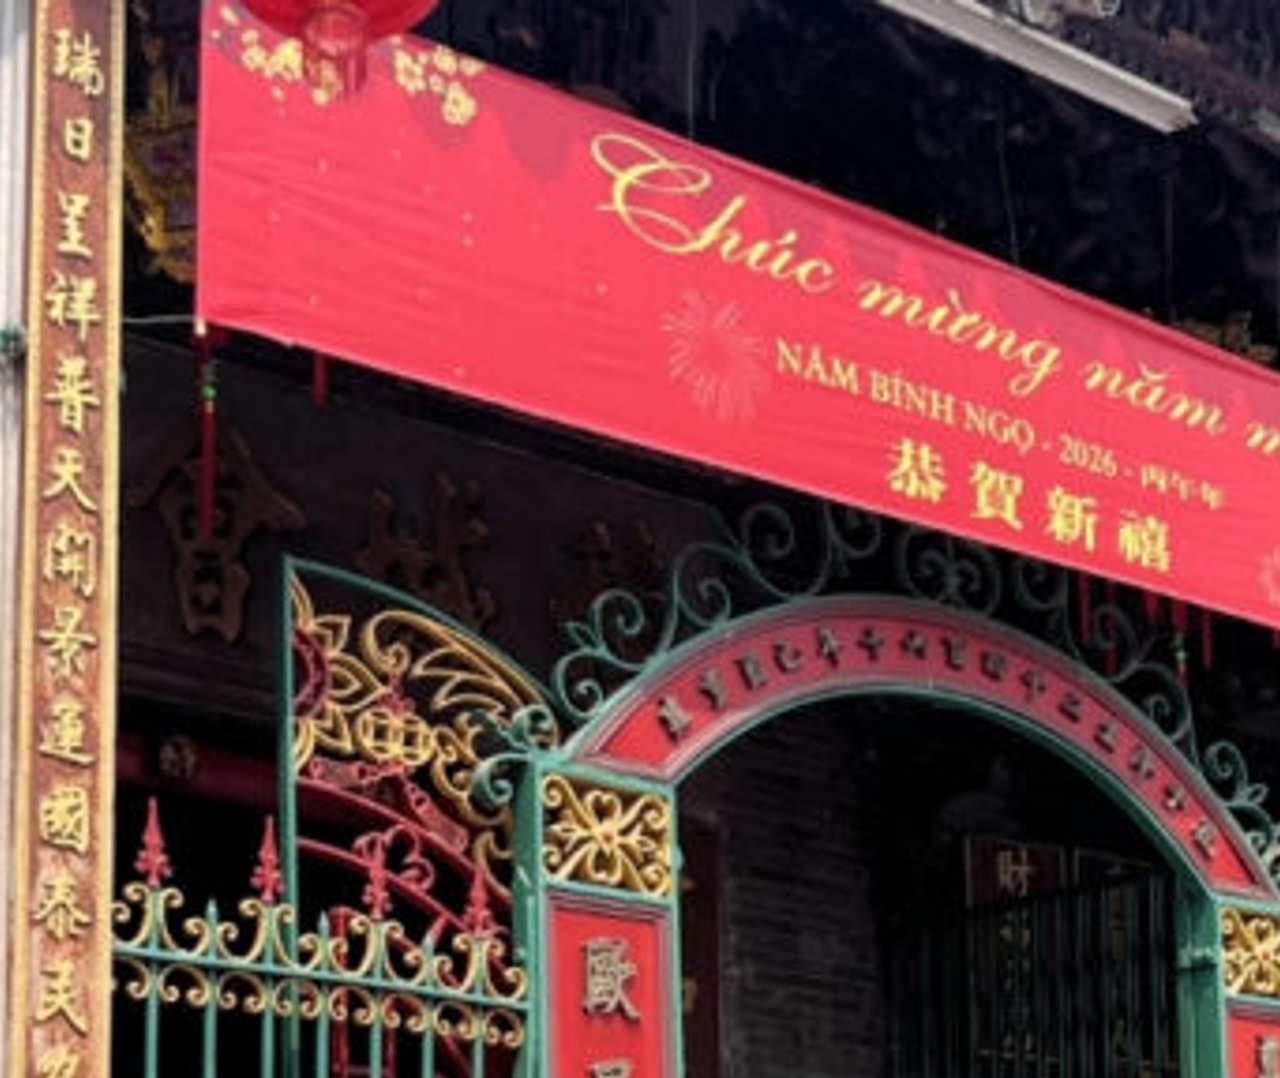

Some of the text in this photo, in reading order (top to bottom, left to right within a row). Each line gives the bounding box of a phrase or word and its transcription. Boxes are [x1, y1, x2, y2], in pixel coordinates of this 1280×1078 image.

[590, 133, 837, 293] Chúc
[853, 278, 1066, 397] mừng
[1081, 361, 1227, 436] năm
[886, 436, 1170, 572] 恭賀新禧
[962, 400, 1036, 456] NGỌ
[1057, 434, 1118, 479] 2026
